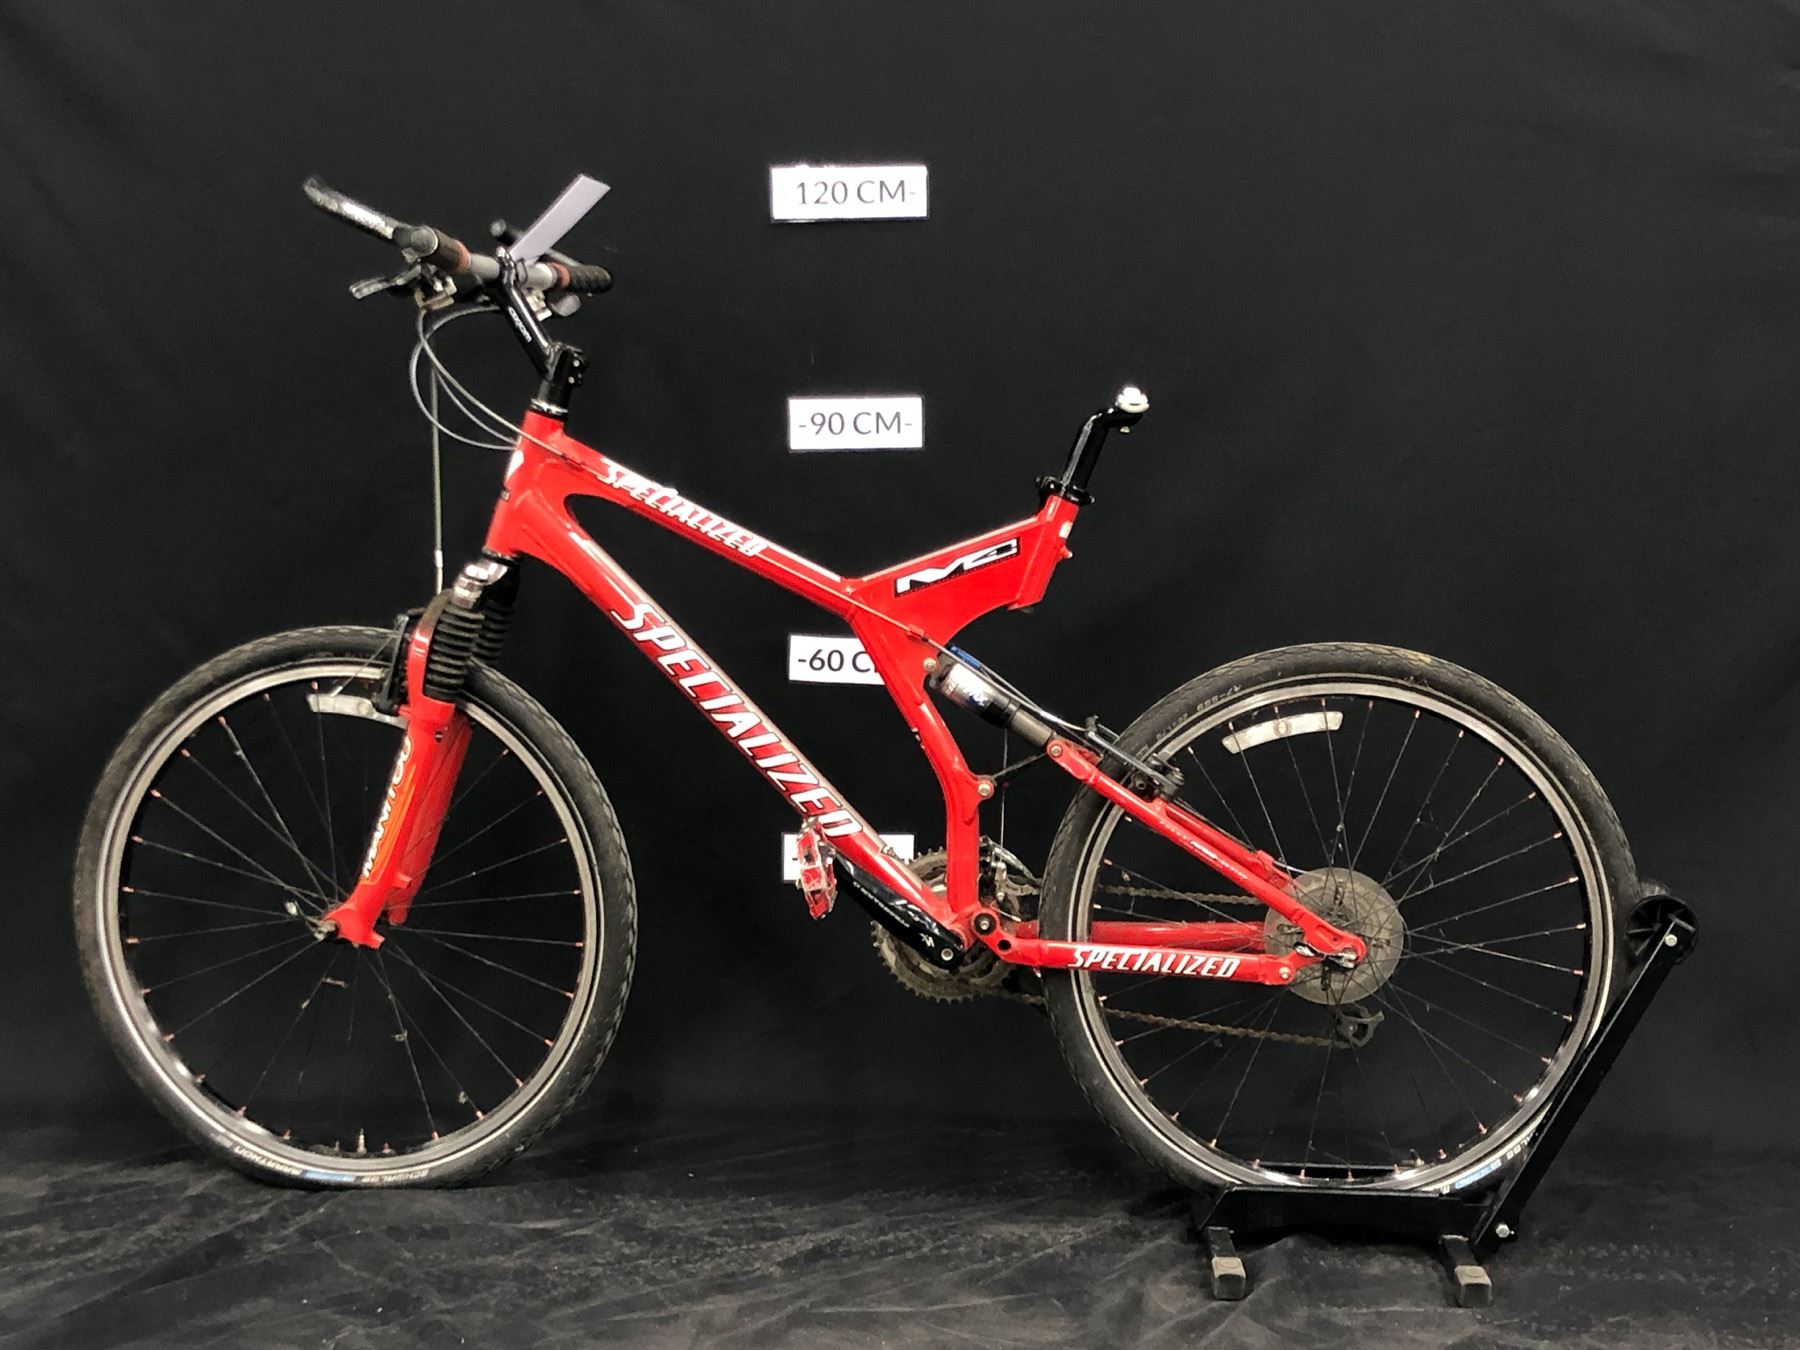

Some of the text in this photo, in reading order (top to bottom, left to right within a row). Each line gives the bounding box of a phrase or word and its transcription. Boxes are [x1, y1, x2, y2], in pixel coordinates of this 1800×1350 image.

[795, 180, 849, 206] 120
[798, 410, 913, 436] -90 CM-
[597, 457, 769, 557] SPECIALIZED
[797, 648, 880, 674] -60 C
[611, 602, 864, 837] SPECIALIZED
[1067, 946, 1241, 979] SPECIALIZED
